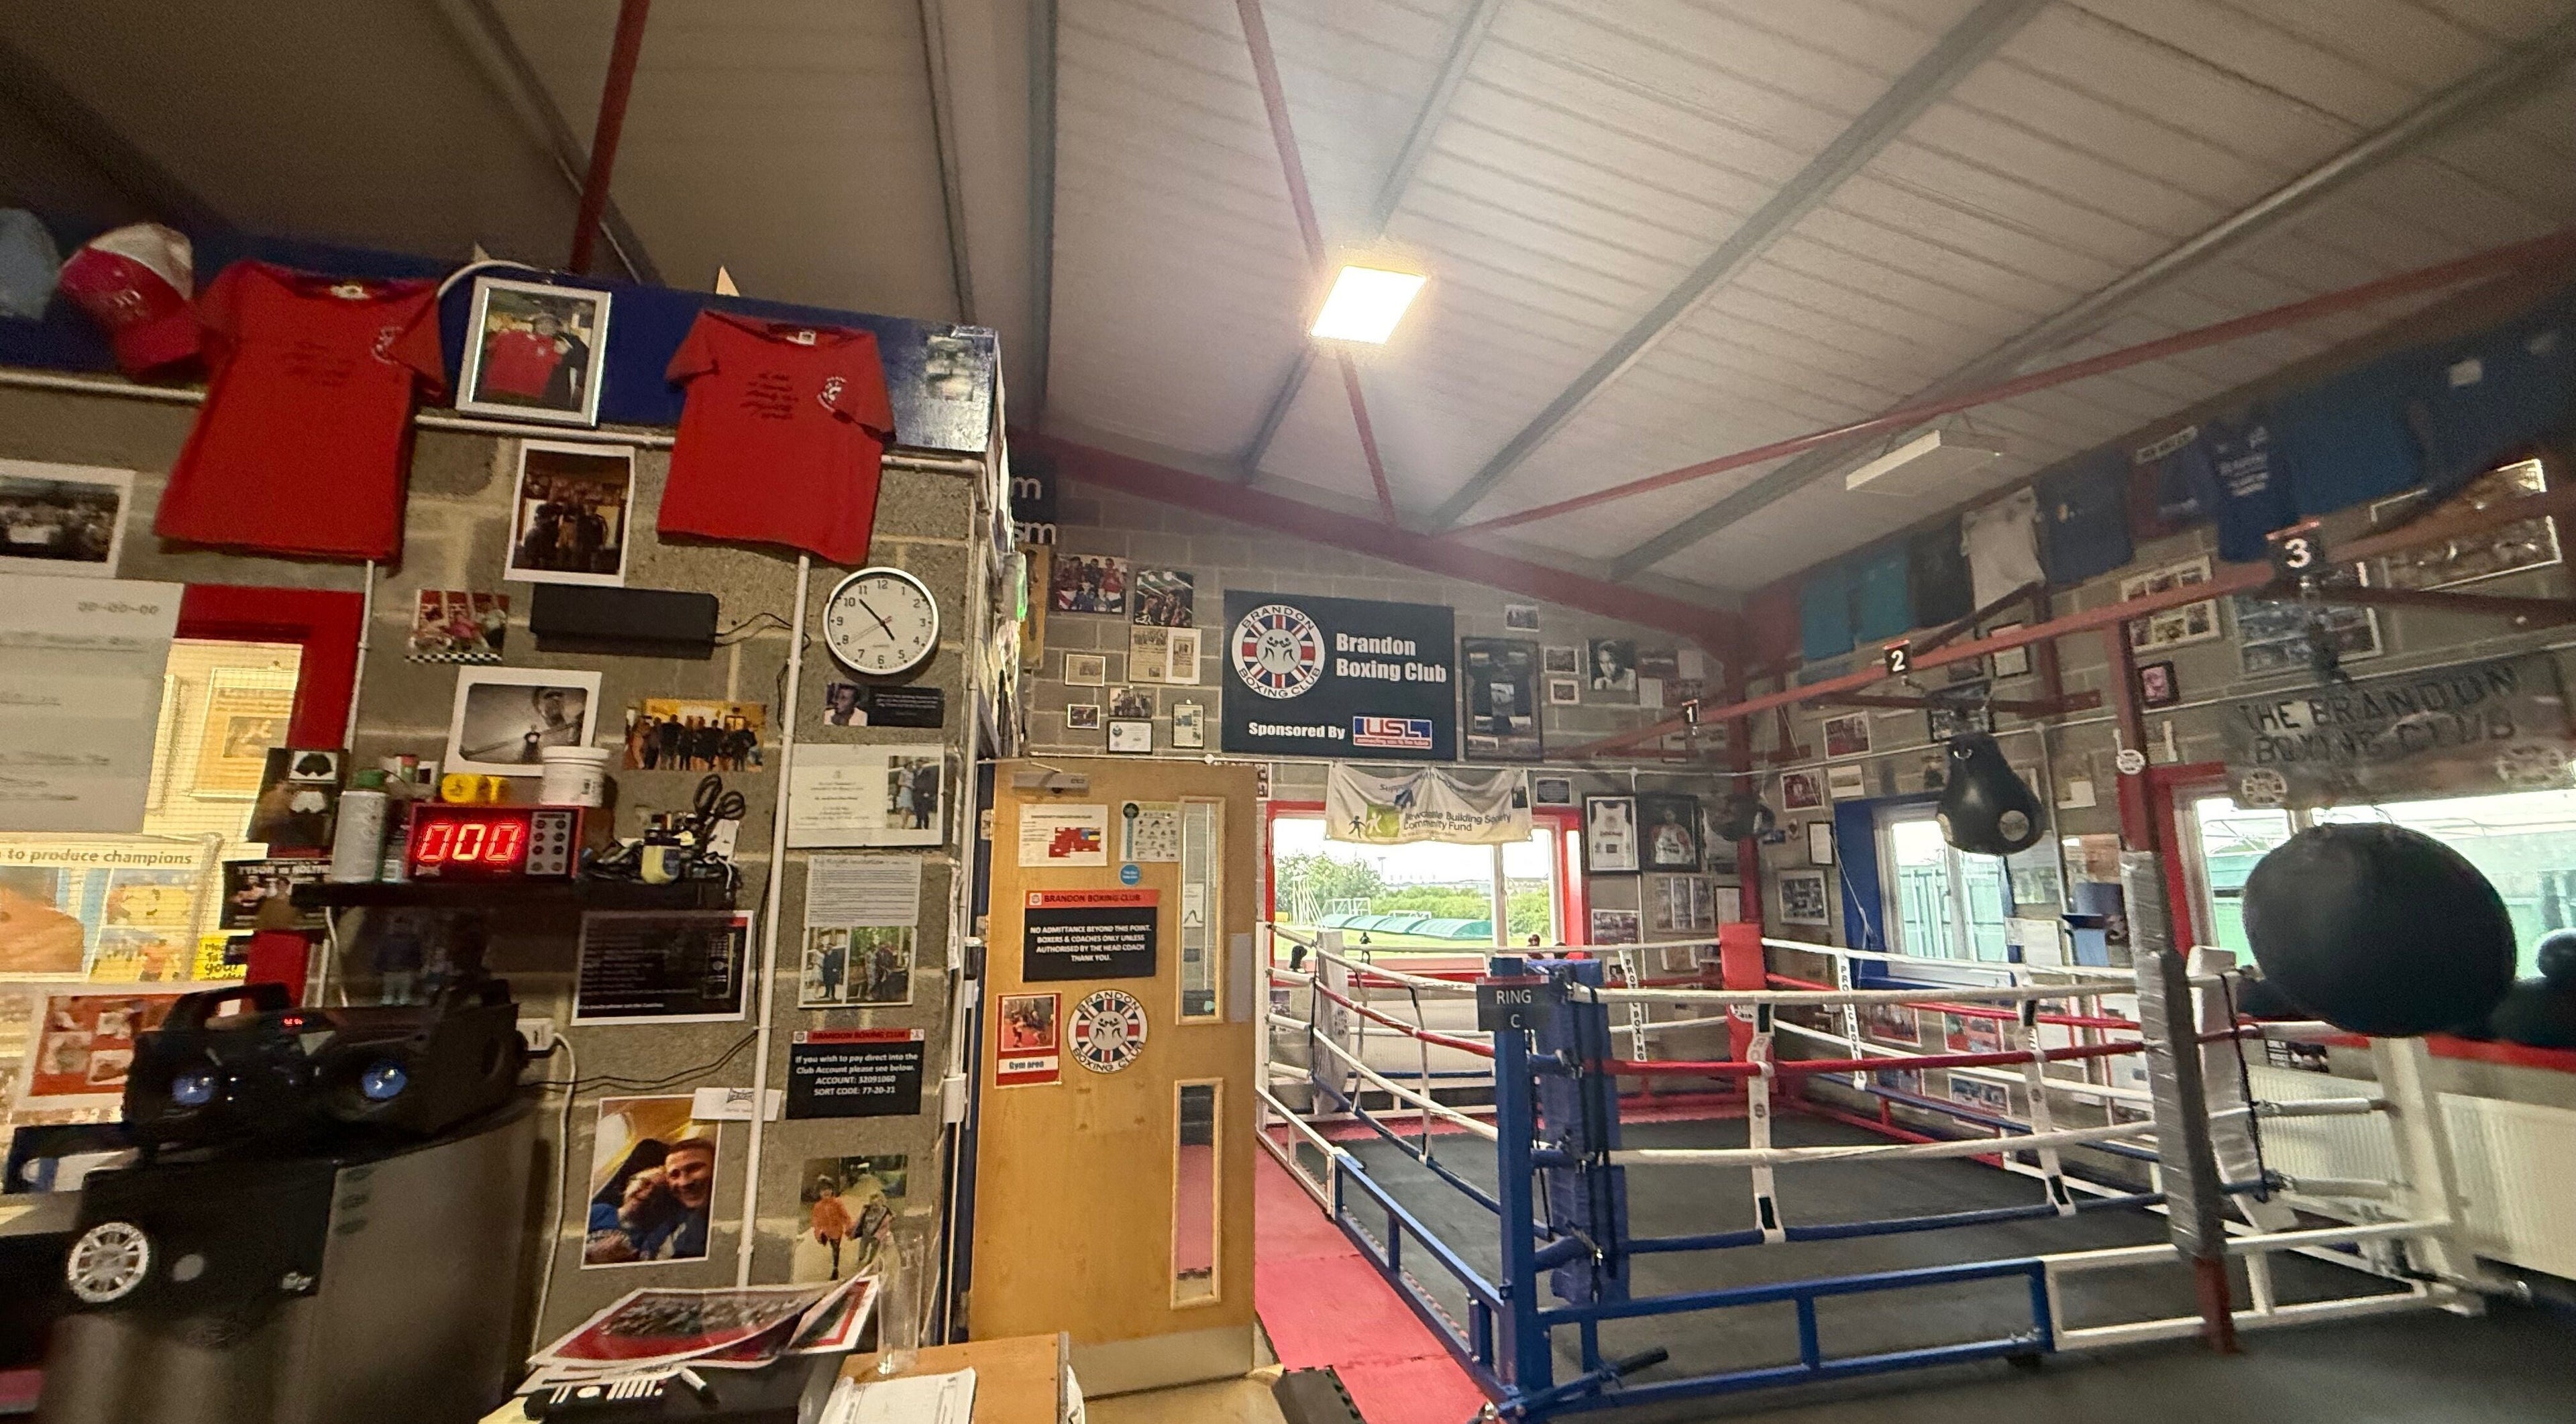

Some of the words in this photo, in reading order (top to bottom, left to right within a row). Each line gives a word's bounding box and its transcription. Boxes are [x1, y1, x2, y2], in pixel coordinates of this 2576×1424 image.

[2285, 539, 2311, 568] 3
[859, 586, 868, 595] 11
[877, 580, 888, 590] 12
[844, 598, 856, 607] 10
[914, 599, 920, 608] 2
[837, 616, 843, 626] 9
[920, 618, 926, 627] 3
[1242, 606, 1315, 631] BRANDON
[843, 635, 849, 645] 8
[913, 637, 920, 645] 4
[1336, 633, 1416, 657] Brandon
[858, 649, 865, 659] 7
[877, 655, 885, 664] 6
[898, 649, 905, 659] 5
[1892, 650, 1905, 671] 2
[1336, 658, 1402, 681] Boxing
[1405, 662, 1447, 683] Club
[1239, 667, 1288, 698] BOXING
[1291, 668, 1320, 695] CLUB
[2239, 701, 2301, 731] THE
[2308, 666, 2520, 726] BRANDON
[1686, 706, 1693, 722] 1
[1248, 722, 1325, 738] Sponsored
[1328, 725, 1345, 739] By
[1366, 718, 1422, 738] USL
[1446, 812, 1481, 824] Building
[1448, 822, 1472, 831] Fund
[8, 848, 25, 859] to
[30, 848, 99, 865] produce
[103, 850, 192, 866] champions
[1044, 895, 1085, 903] BRANDON
[1042, 926, 1085, 934] ADMITTANCE
[1077, 991, 1140, 1013] BRANDON
[1497, 989, 1532, 1005] RING
[1511, 1014, 1521, 1028] C
[1633, 1011, 1646, 1060] BOXING
[1073, 1048, 1113, 1071] BOXING
[1118, 1041, 1144, 1068] CLUB
[849, 1065, 873, 1074] please
[815, 1076, 857, 1085] ACCOUNT:
[814, 1088, 834, 1096] SORT
[836, 1087, 860, 1095] CODE:
